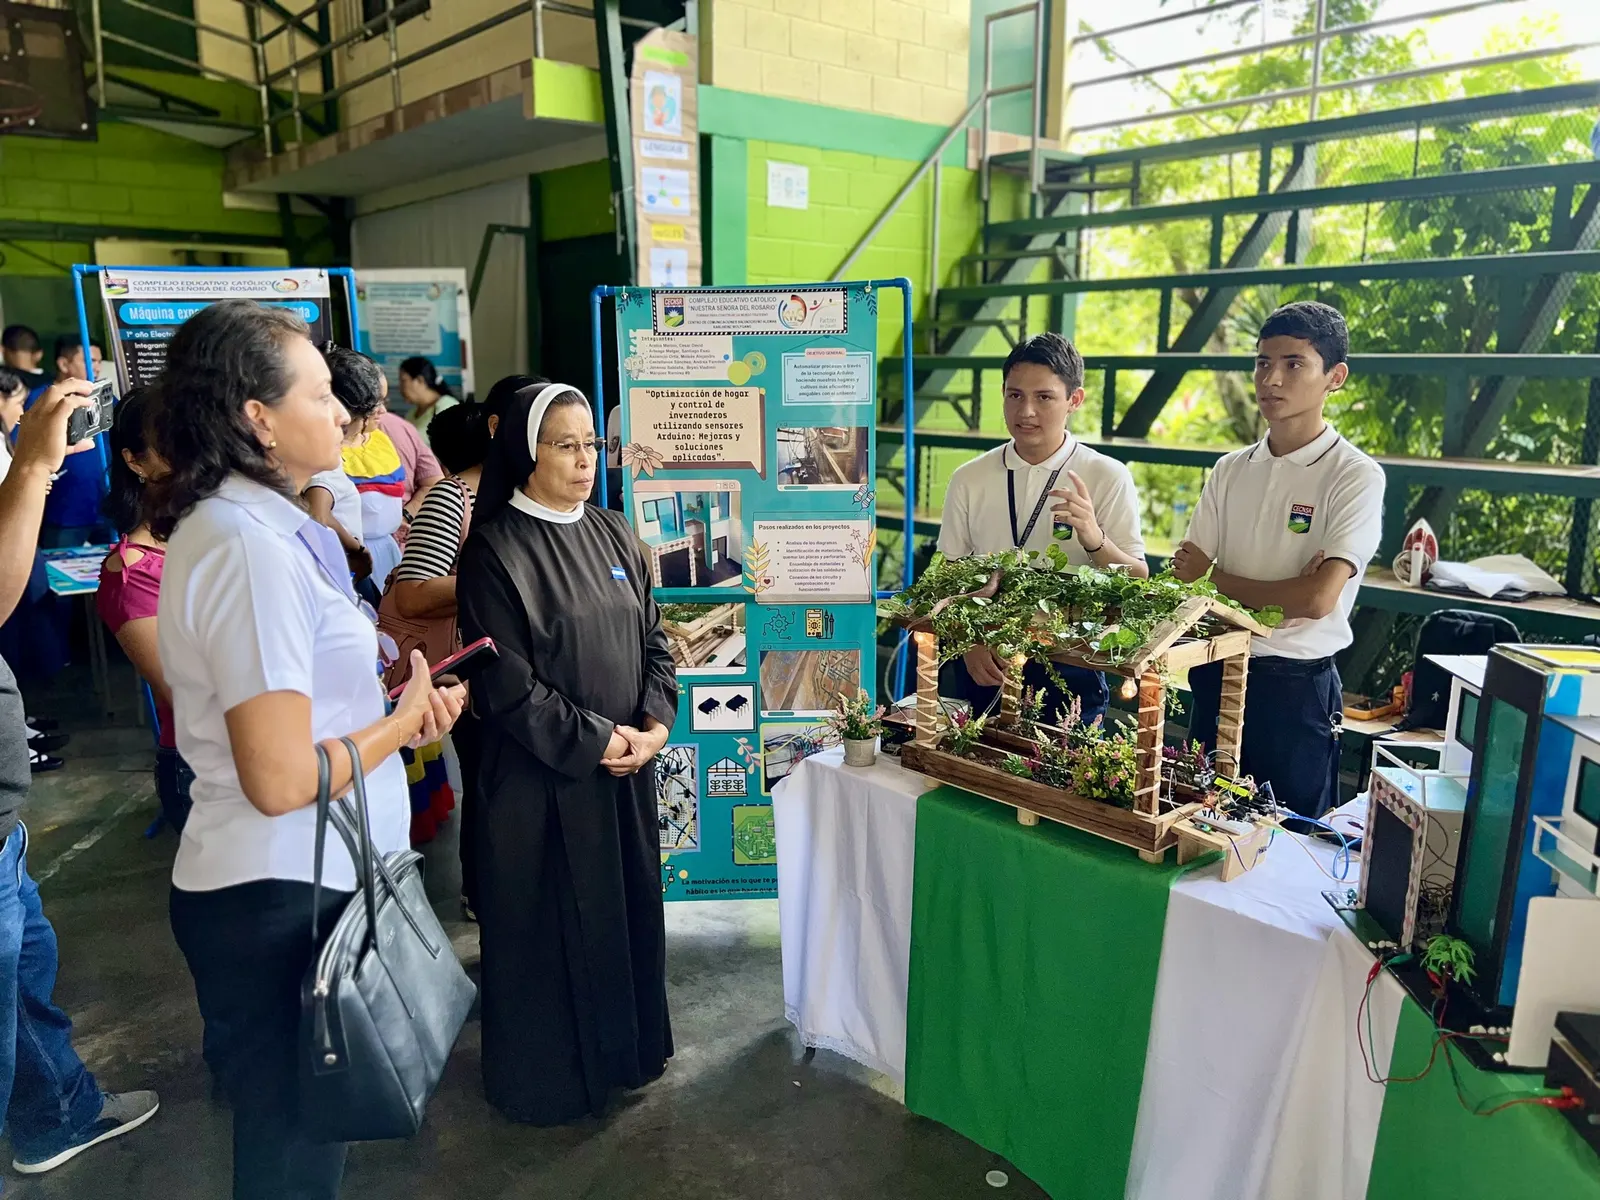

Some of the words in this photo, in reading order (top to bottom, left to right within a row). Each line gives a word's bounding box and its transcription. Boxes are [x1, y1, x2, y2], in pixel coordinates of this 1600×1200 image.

[130, 307, 174, 321] Máquina
[724, 390, 749, 399] hogar
[671, 402, 676, 410] y
[715, 400, 725, 408] de
[653, 422, 702, 430] utilizando
[657, 432, 696, 440] Arduino:
[699, 432, 733, 441] Mejoras
[735, 433, 740, 441] y
